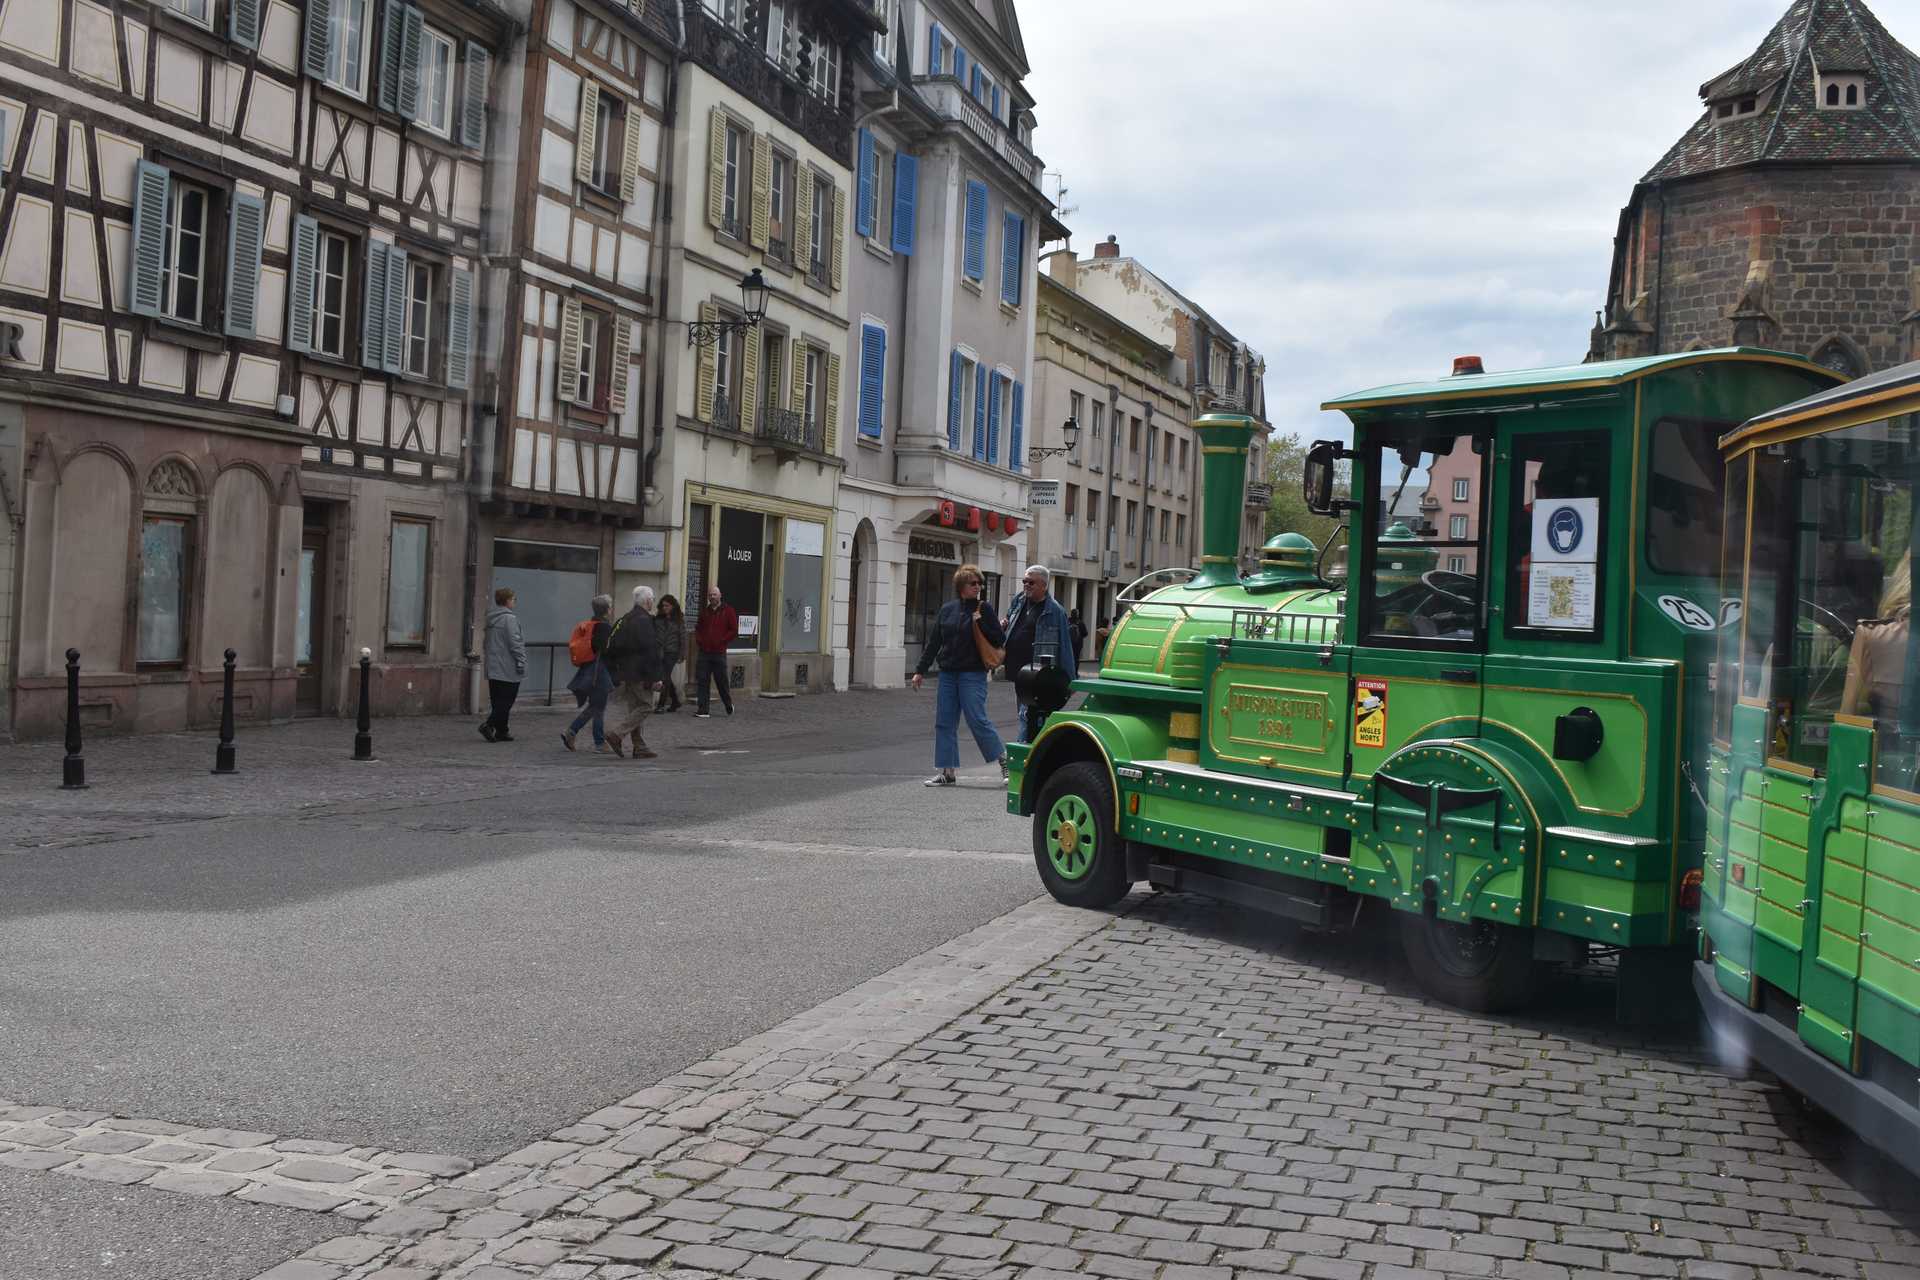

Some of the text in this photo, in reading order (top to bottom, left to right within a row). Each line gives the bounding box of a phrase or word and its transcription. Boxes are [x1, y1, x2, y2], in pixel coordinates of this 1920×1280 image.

[727, 546, 752, 561] À LOUER
[1663, 598, 1711, 627] 25
[1358, 681, 1386, 690] ATTENTION
[1359, 726, 1382, 735] ANGLES
[1360, 734, 1381, 743] MORTS
